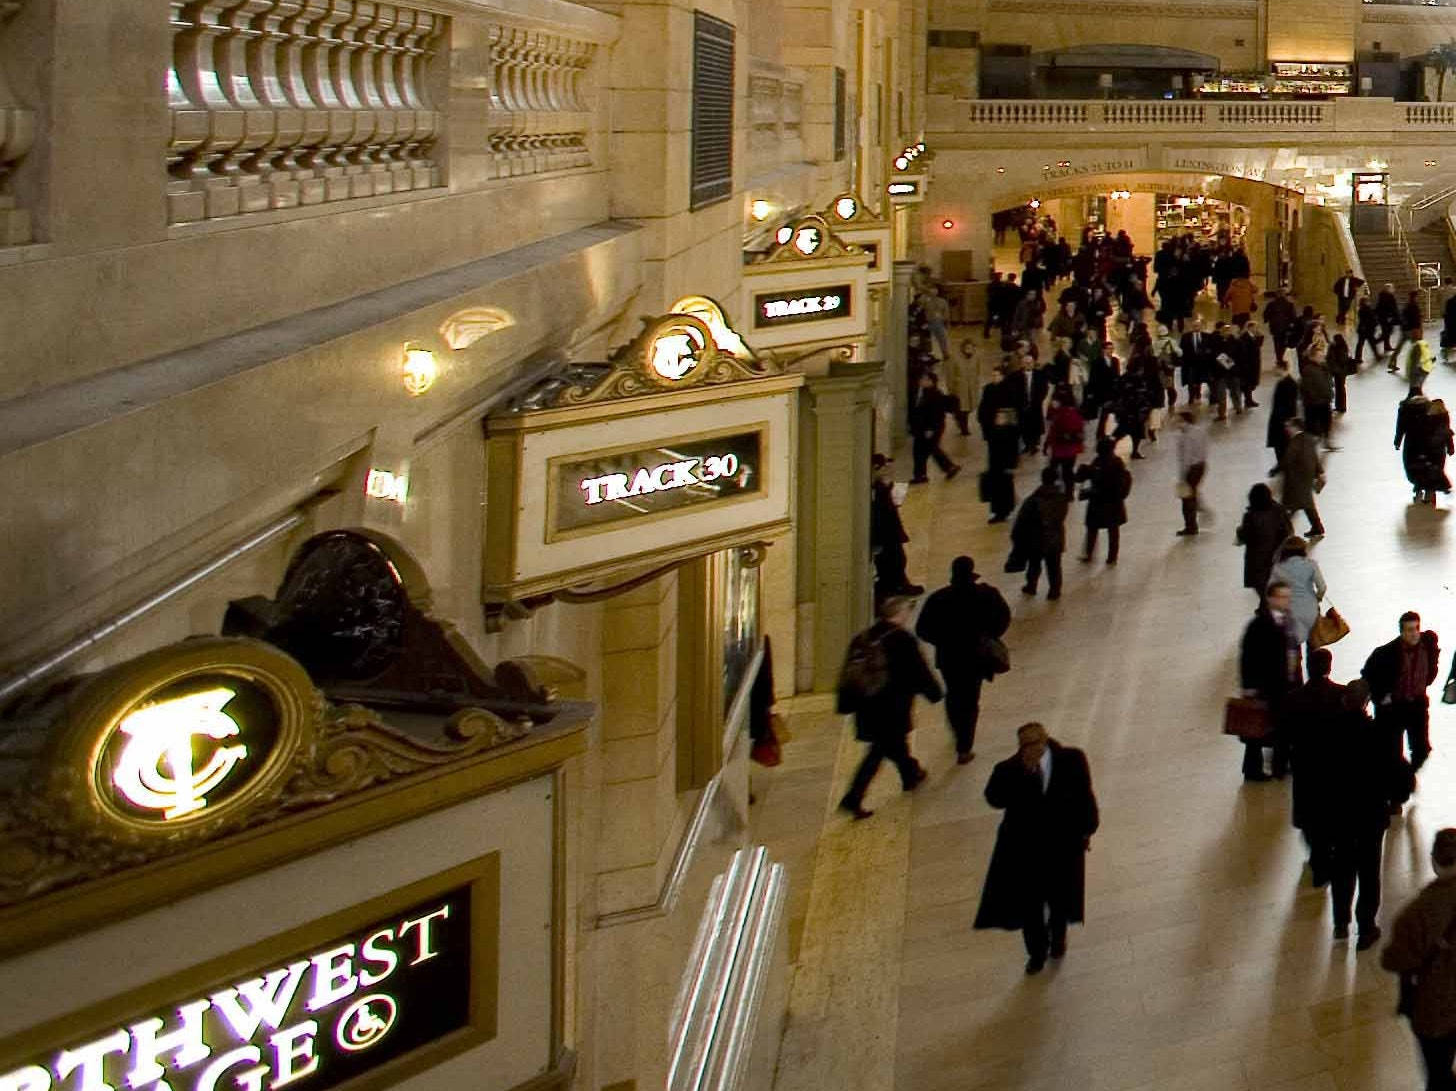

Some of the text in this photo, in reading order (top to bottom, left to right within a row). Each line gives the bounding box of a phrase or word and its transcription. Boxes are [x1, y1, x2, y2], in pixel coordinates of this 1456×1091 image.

[762, 296, 823, 318] TRACK
[580, 453, 738, 505] TRACK 30
